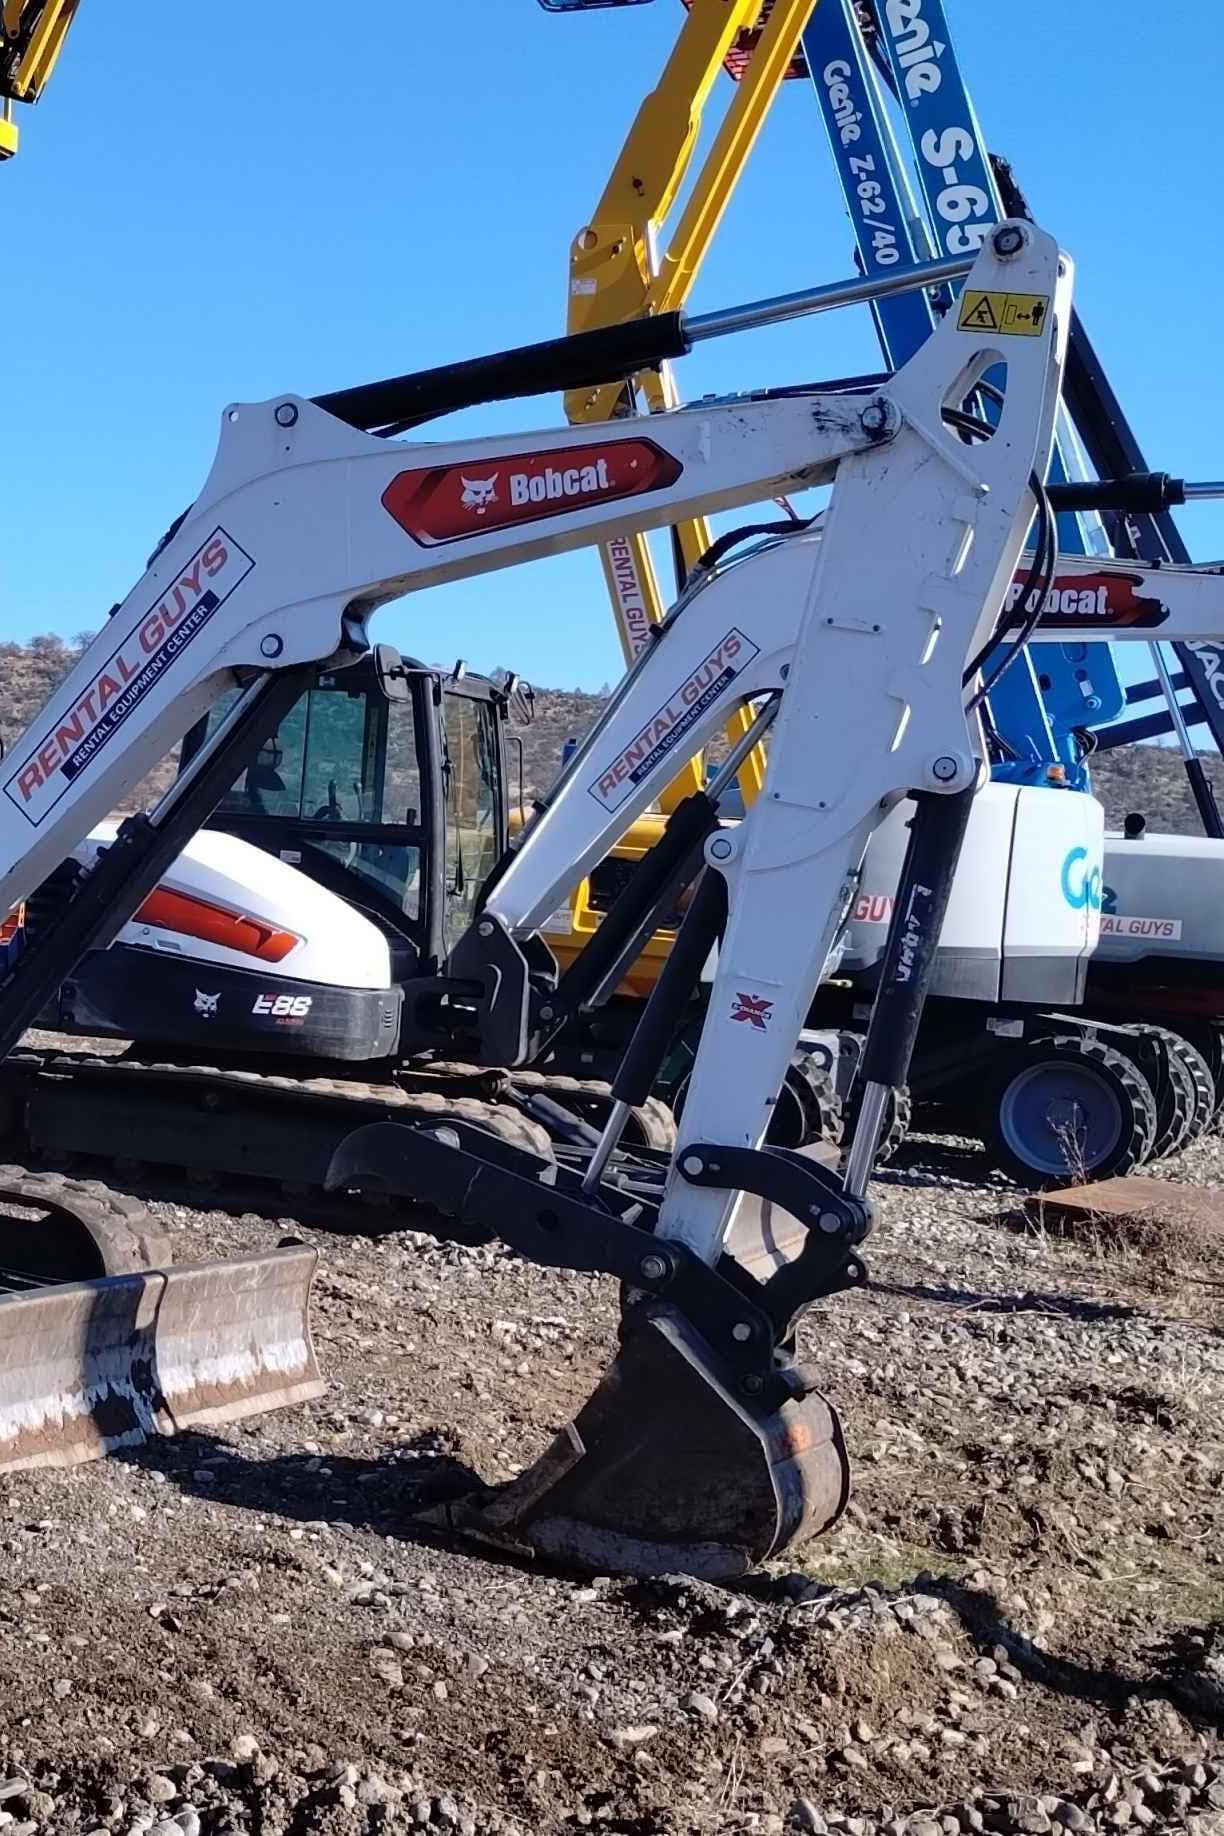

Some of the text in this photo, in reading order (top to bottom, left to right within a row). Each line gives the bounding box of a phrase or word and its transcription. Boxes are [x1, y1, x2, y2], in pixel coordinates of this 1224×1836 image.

[823, 59, 900, 265] Genie Z-62/40
[510, 458, 609, 506] Bobcat
[610, 537, 637, 603] RENTAL
[17, 538, 228, 801] RENTAL GUYS
[73, 604, 210, 767] RENTAL EQUIPMENT CENTER
[598, 636, 741, 799] RENTAL GUYS
[1129, 920, 1174, 936] GUYS
